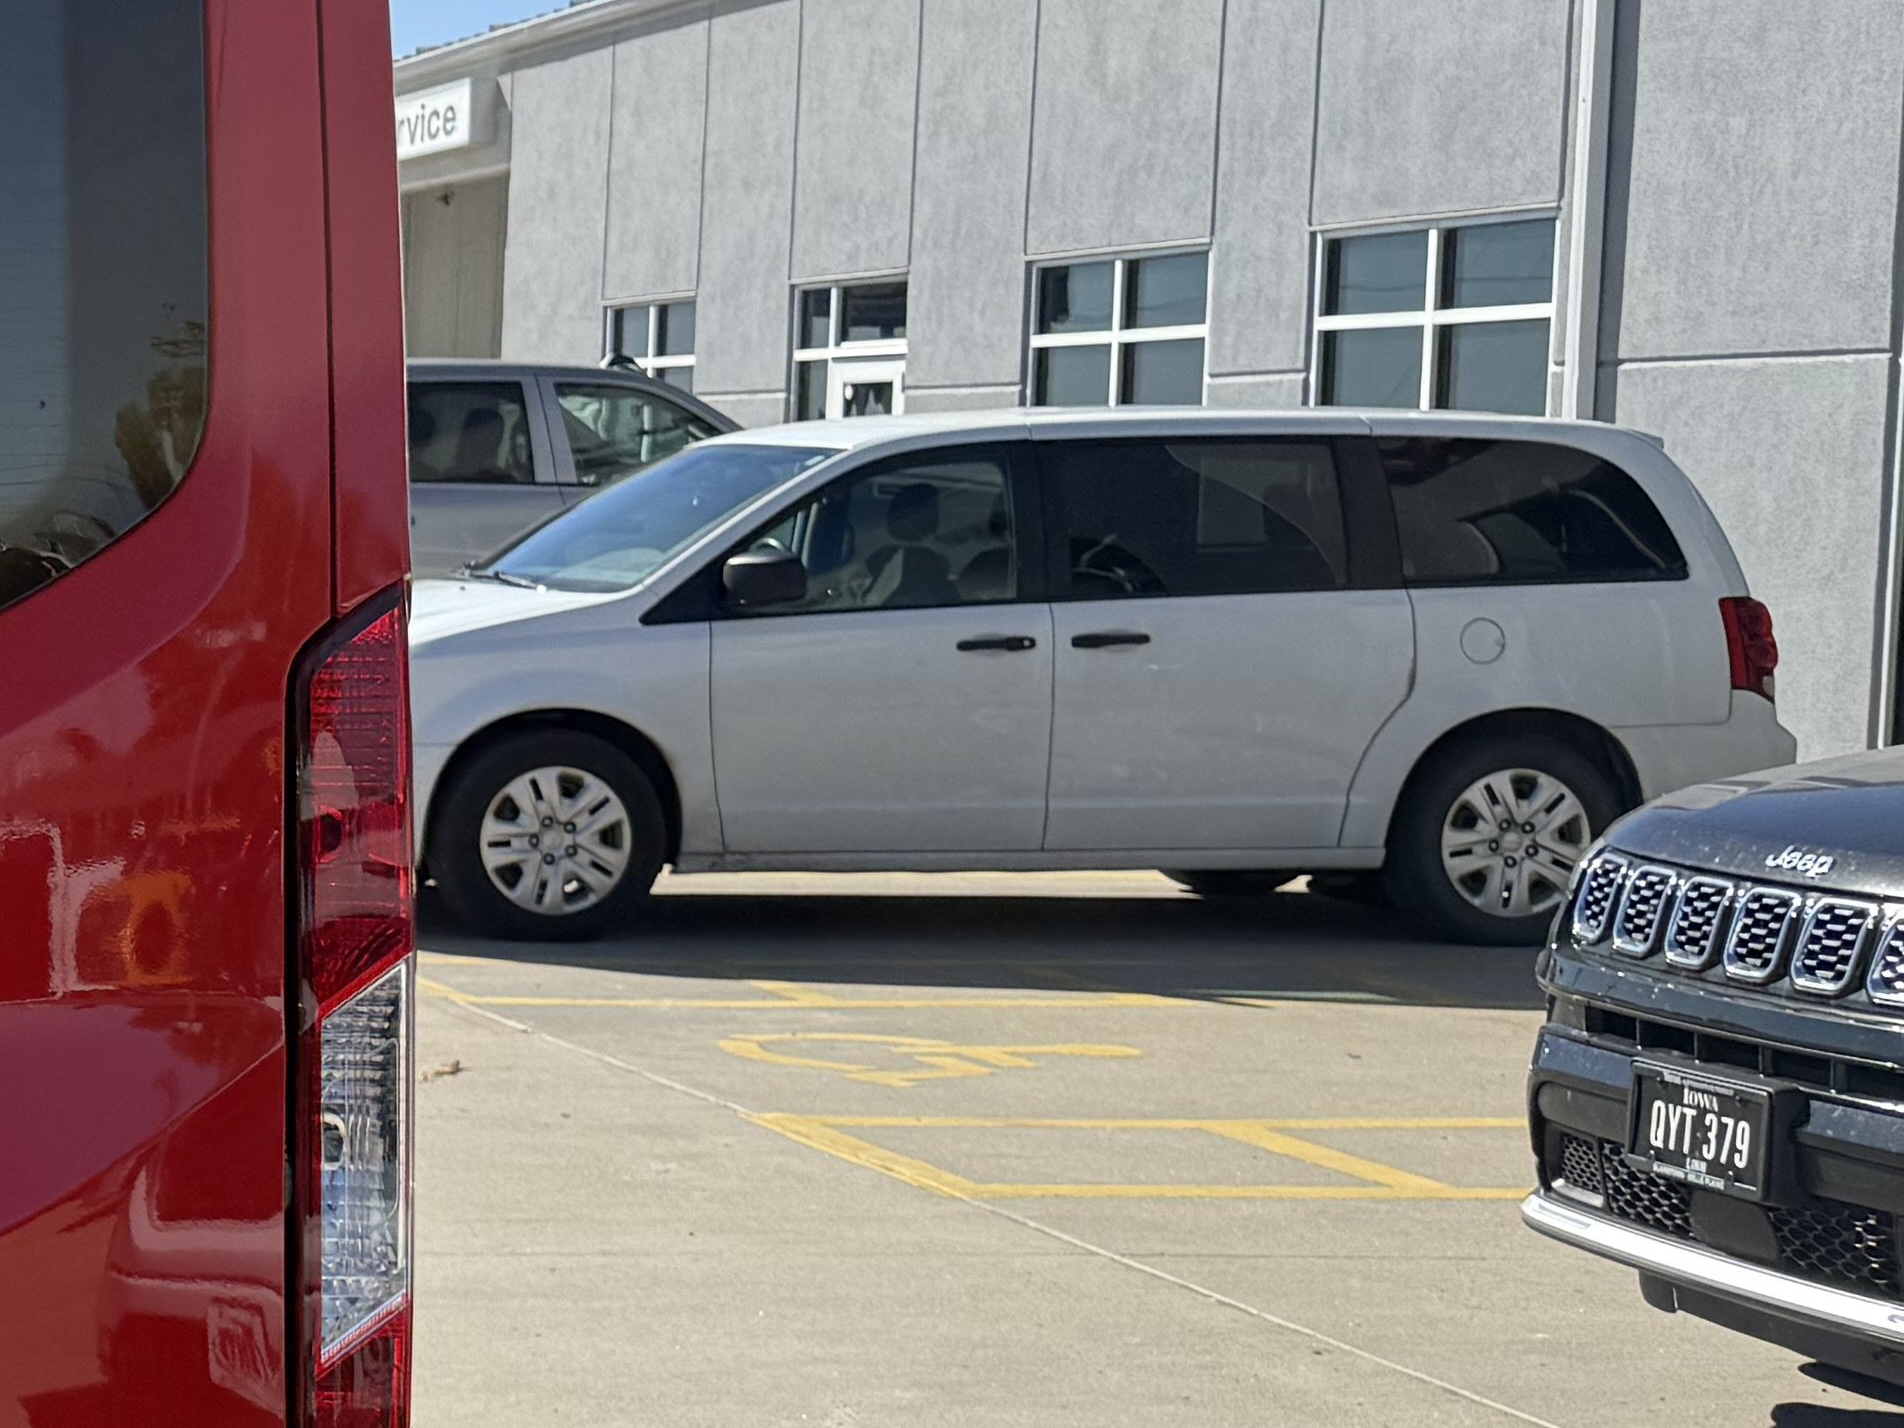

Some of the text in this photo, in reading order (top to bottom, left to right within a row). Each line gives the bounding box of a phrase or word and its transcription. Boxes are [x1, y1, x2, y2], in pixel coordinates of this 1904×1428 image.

[1765, 845, 1834, 878] Jeep
[1649, 1099, 1751, 1169] QYT 379
